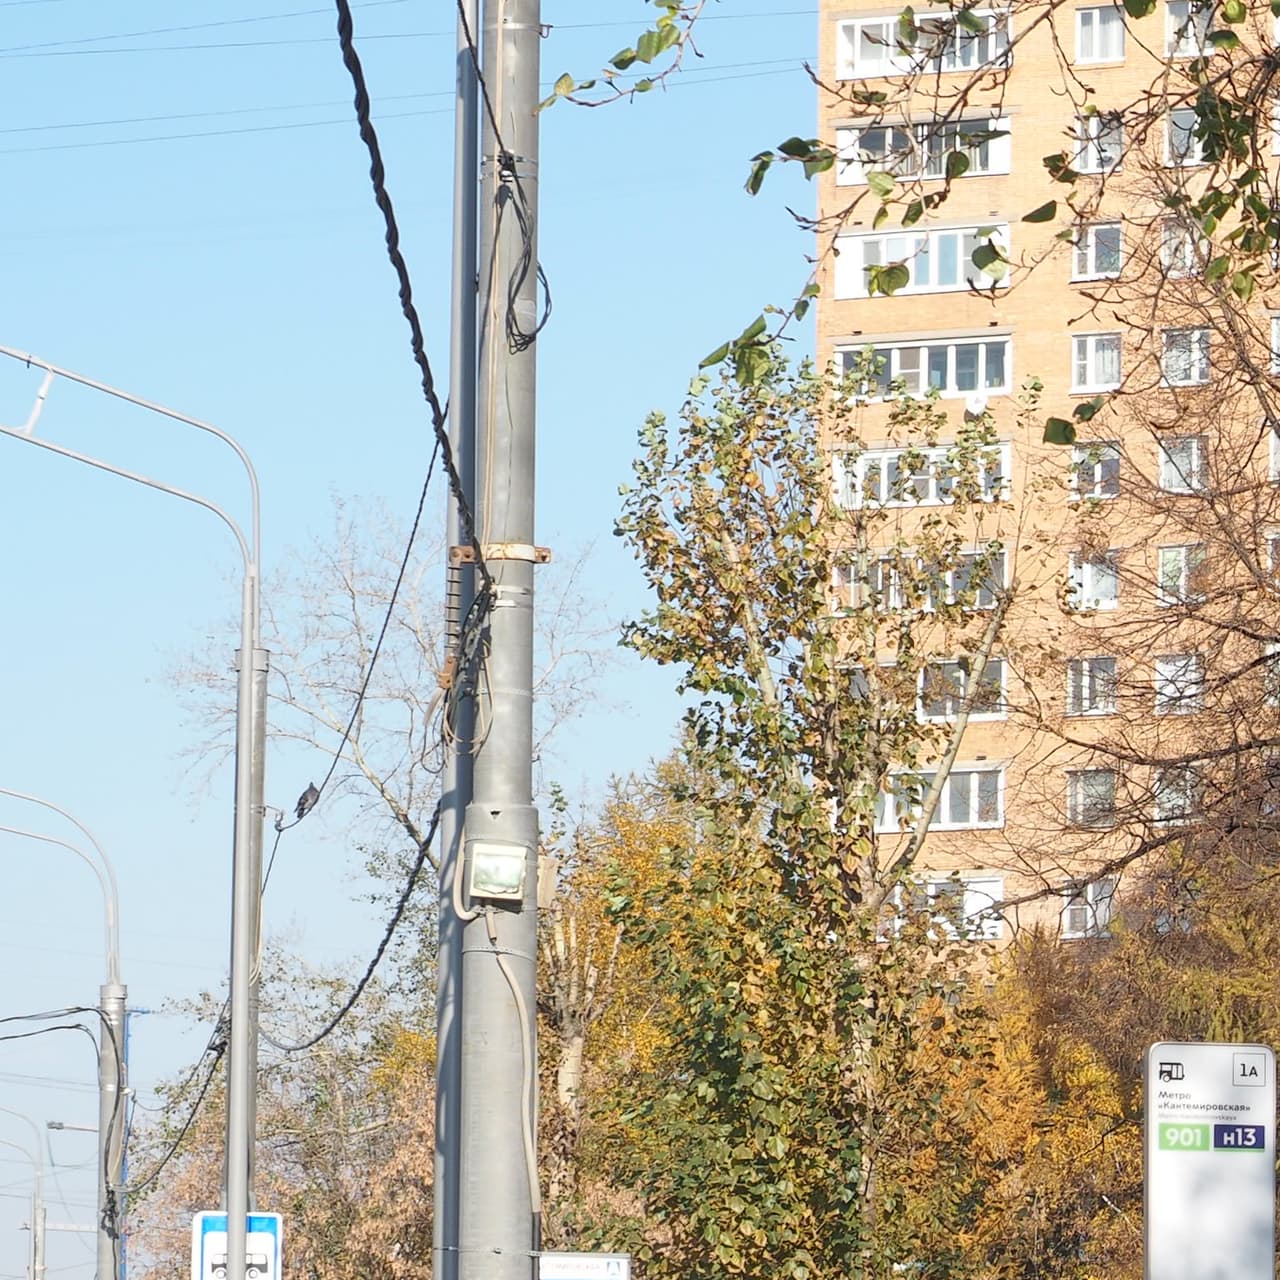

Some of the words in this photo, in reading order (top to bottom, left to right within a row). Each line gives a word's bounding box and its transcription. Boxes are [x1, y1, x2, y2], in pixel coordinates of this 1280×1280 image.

[1158, 1091, 1192, 1102] Метро
[1166, 1128, 1202, 1147] 901
[1223, 1128, 1257, 1146] н13
